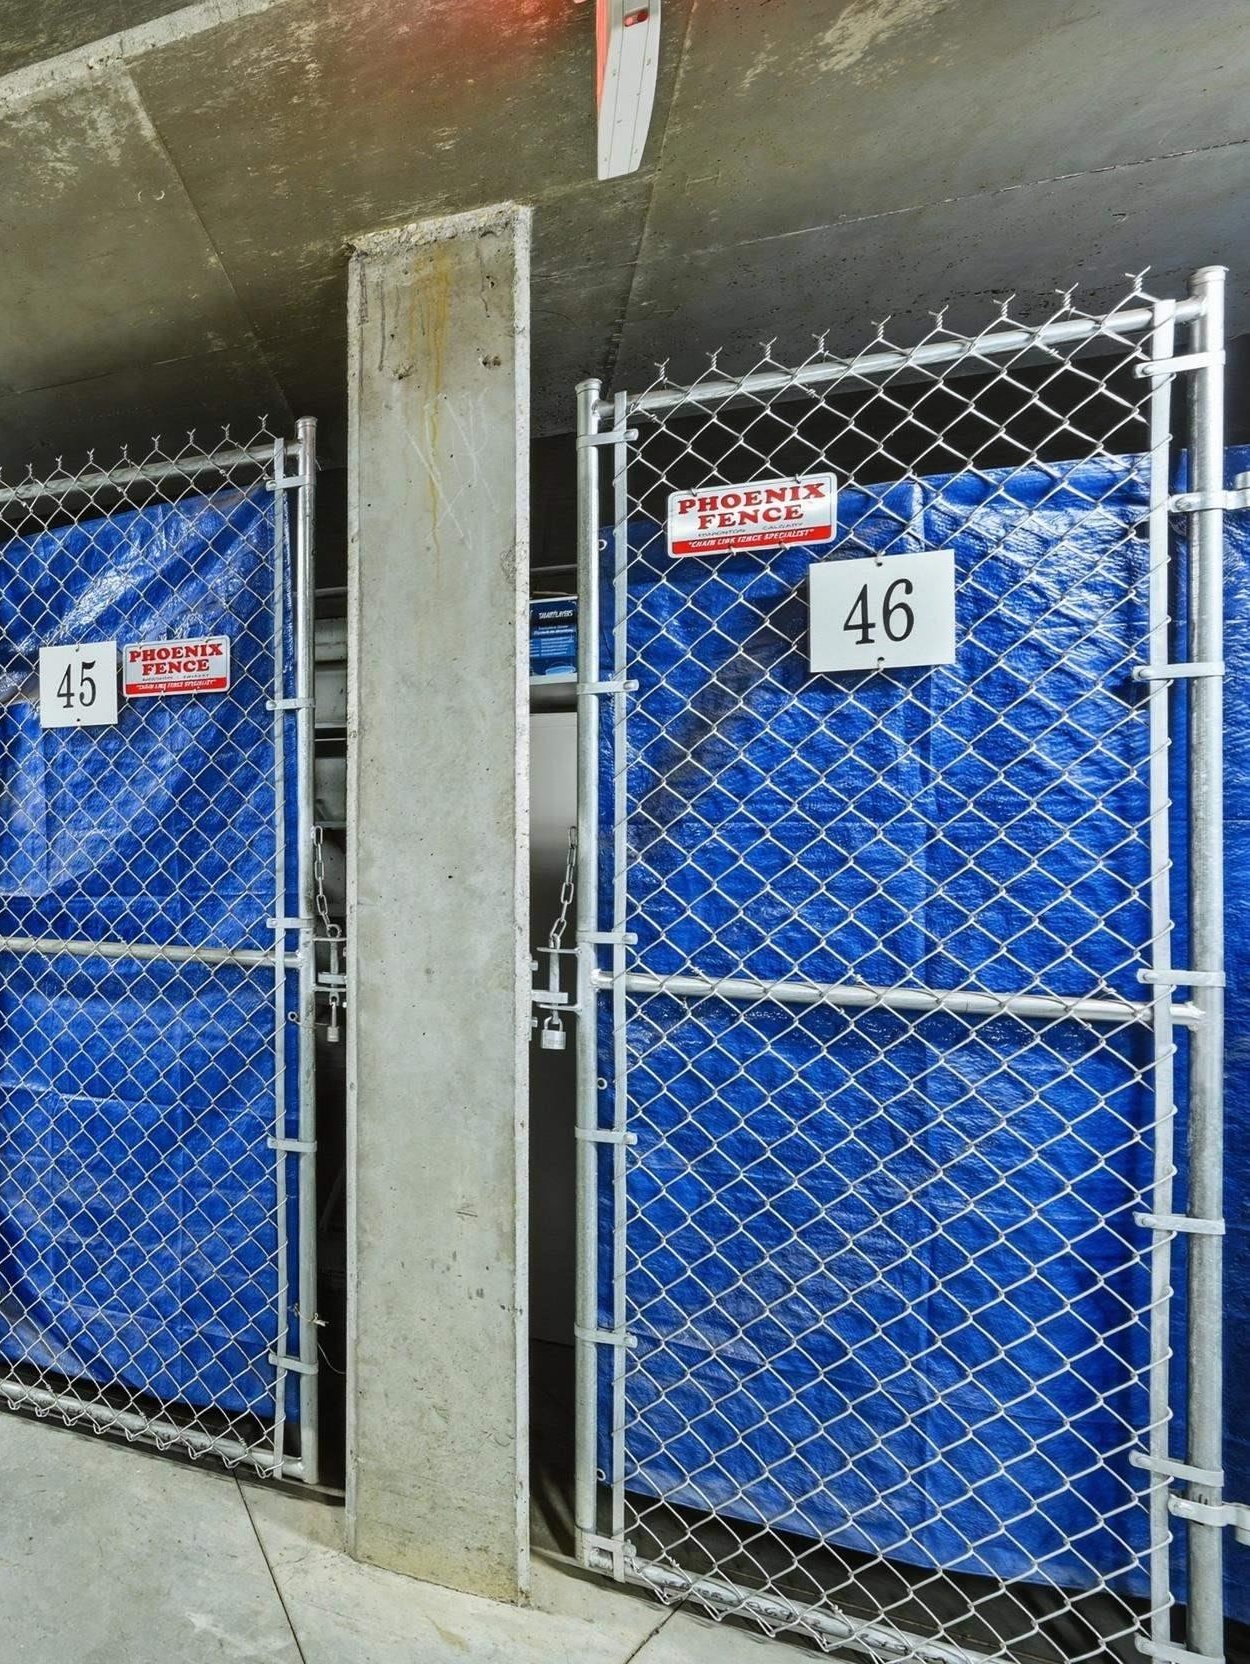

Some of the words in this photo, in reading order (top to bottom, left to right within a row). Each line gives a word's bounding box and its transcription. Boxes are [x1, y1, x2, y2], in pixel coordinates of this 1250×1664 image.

[678, 482, 826, 514] PHOENIX
[697, 504, 804, 530] FENCE
[843, 578, 915, 645] 46
[129, 643, 223, 663] PHOENIX
[142, 659, 210, 676] FENCE
[56, 660, 97, 709] 45
